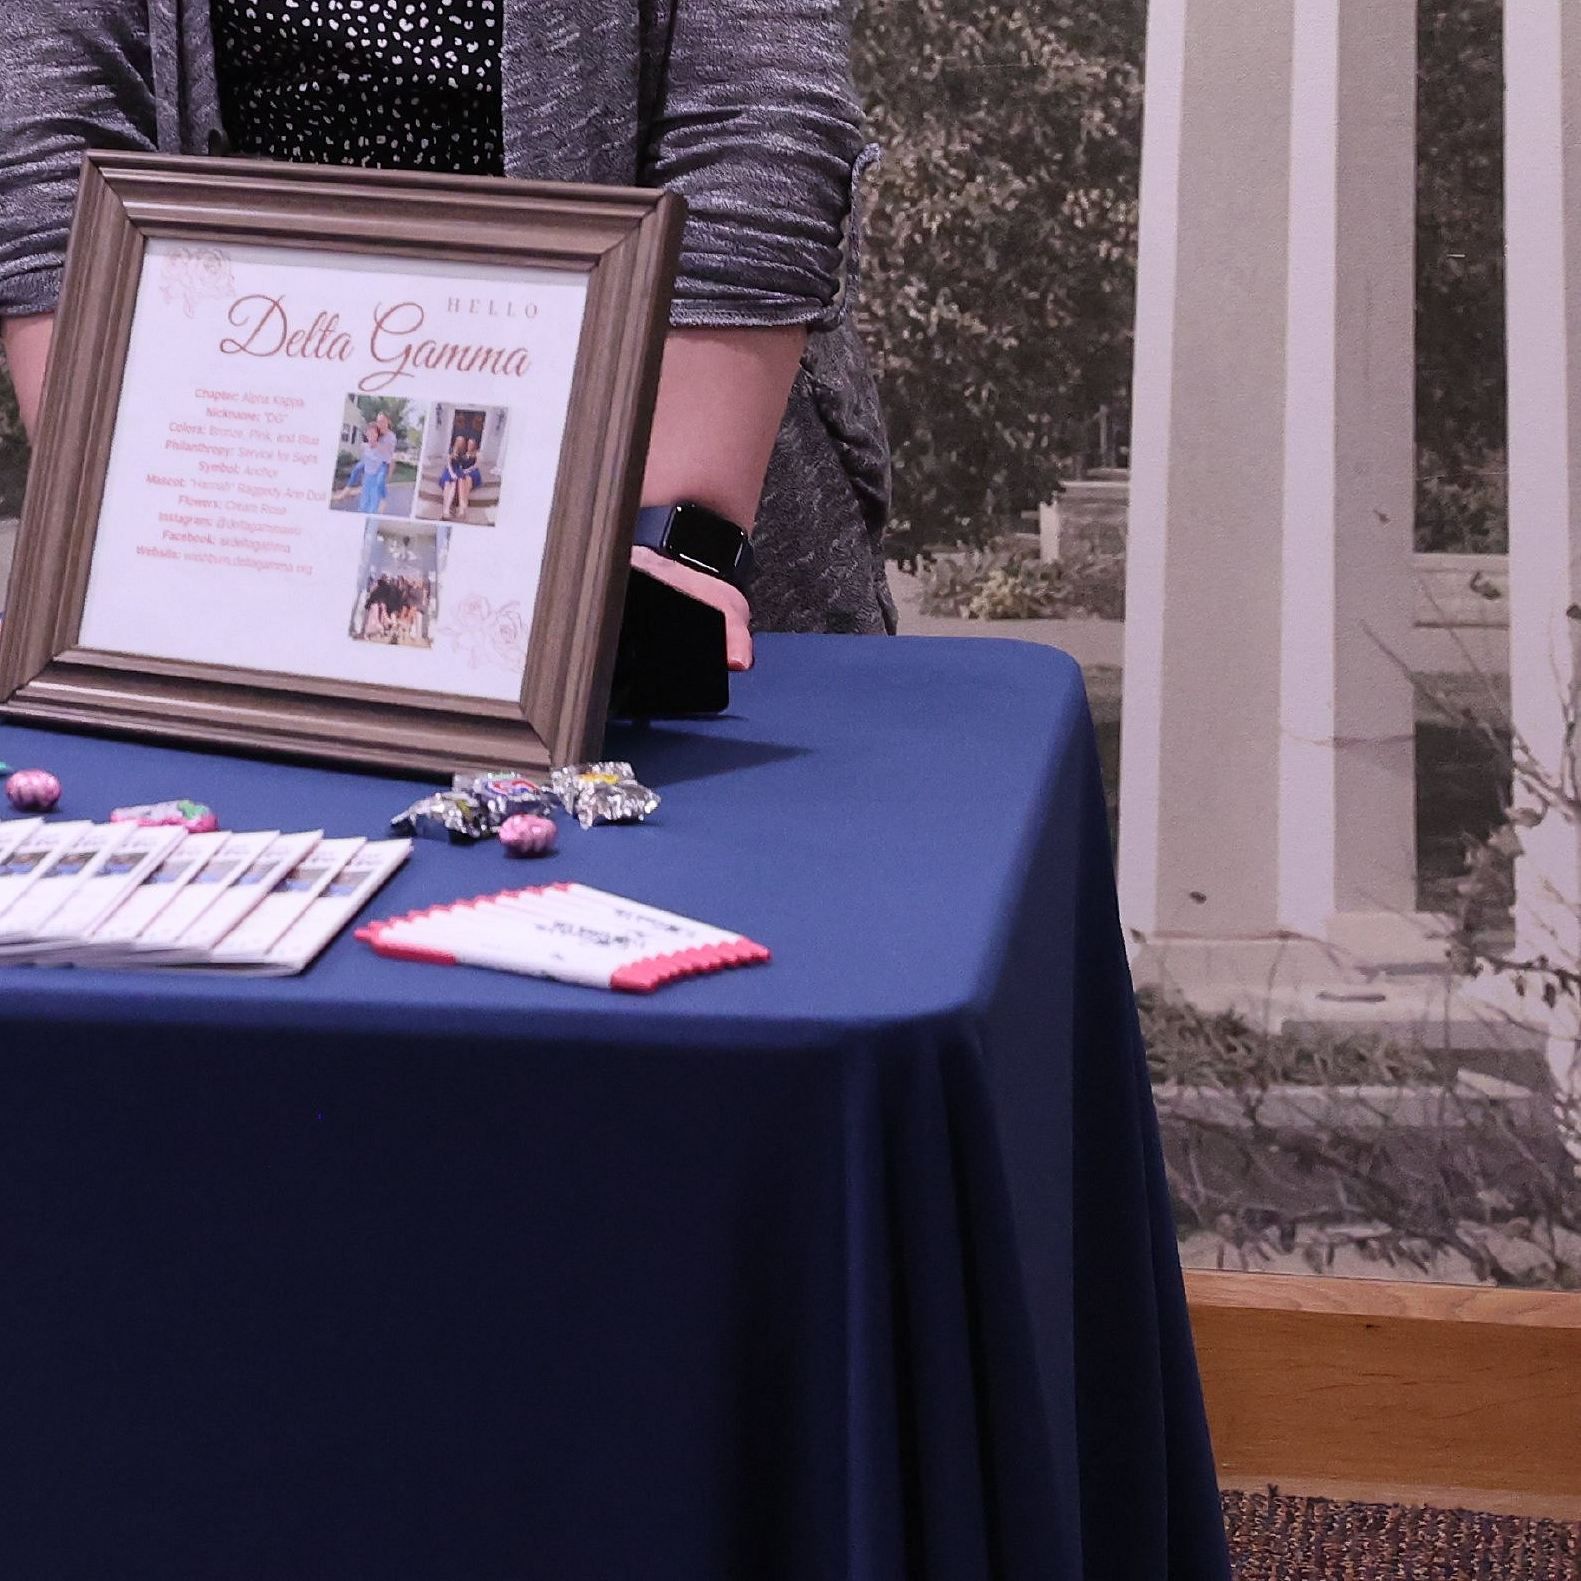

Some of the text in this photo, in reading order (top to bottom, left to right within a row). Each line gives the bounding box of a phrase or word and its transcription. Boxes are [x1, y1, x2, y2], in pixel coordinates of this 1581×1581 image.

[446, 295, 539, 317] HELLO
[219, 293, 532, 393] Delta Gamma
